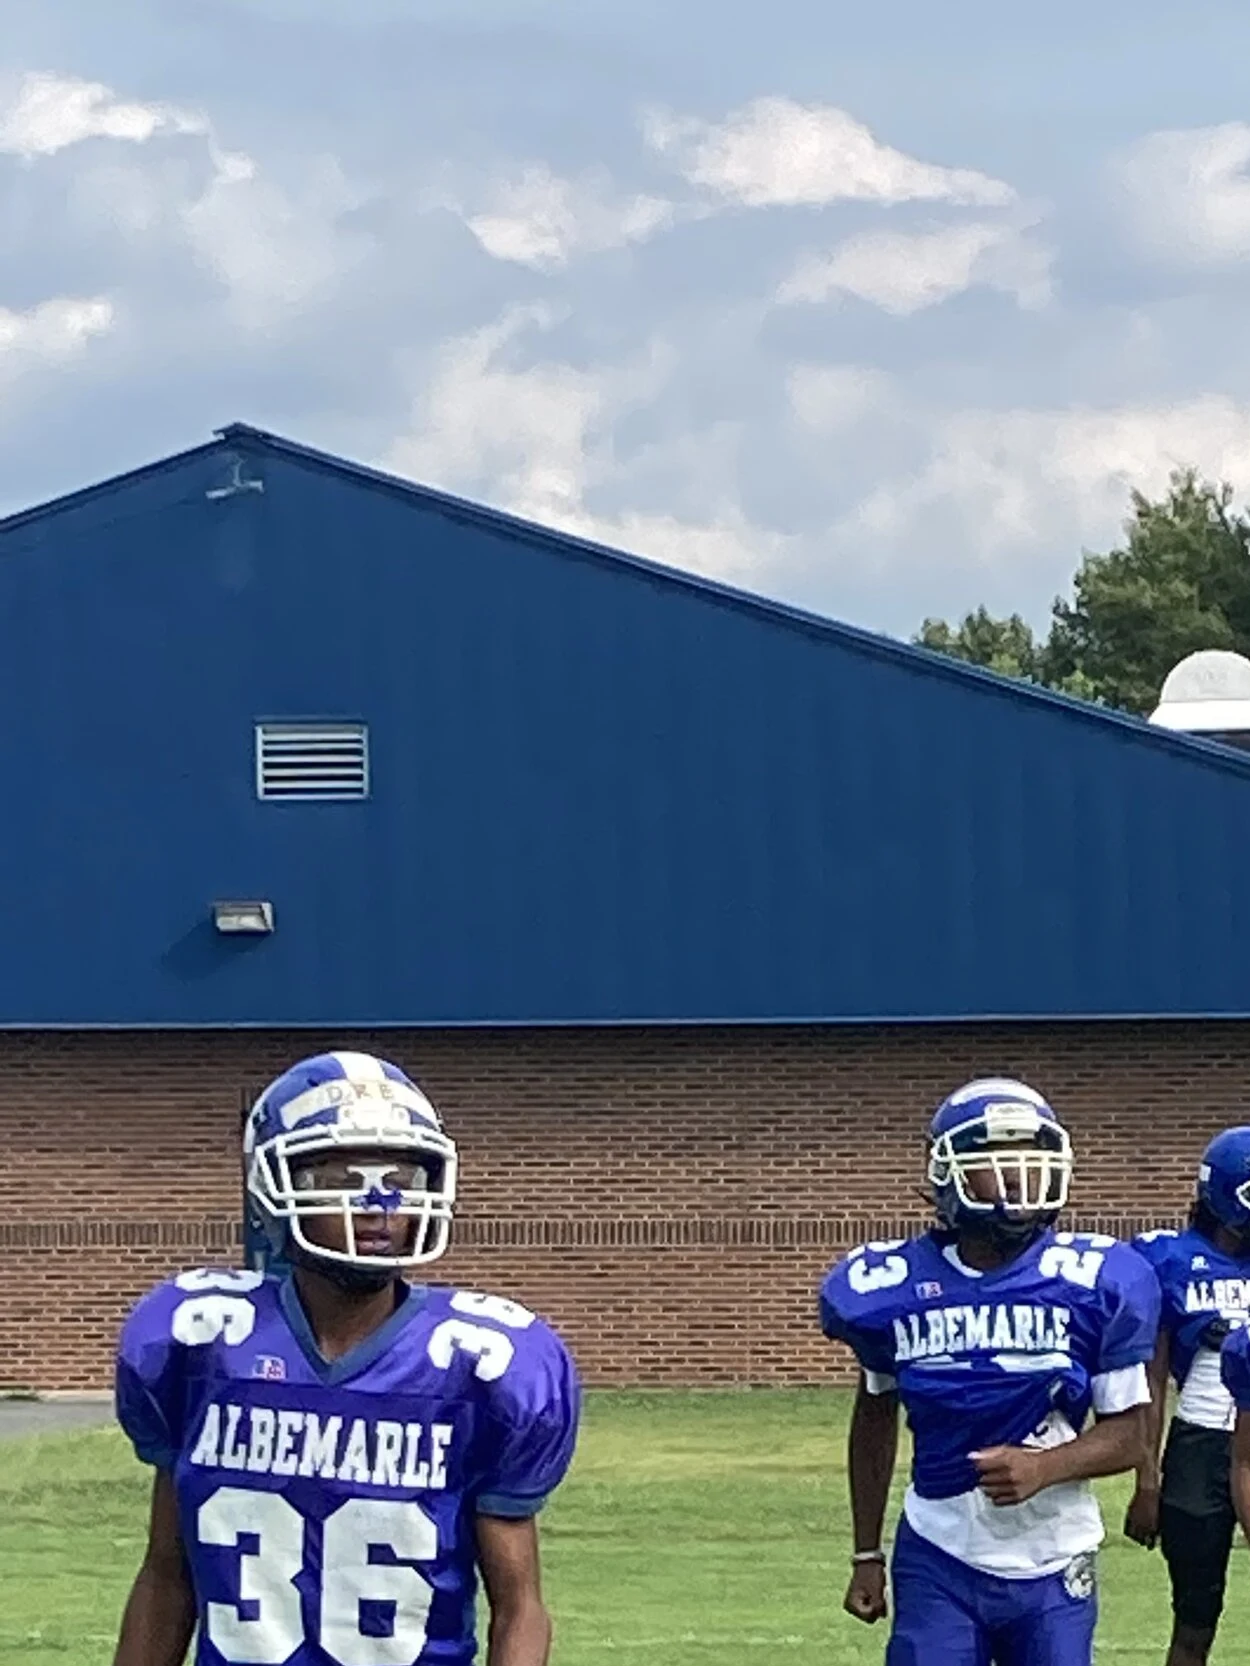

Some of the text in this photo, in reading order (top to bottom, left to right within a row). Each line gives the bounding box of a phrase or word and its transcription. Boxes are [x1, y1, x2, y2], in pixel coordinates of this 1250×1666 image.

[171, 1268, 264, 1346] 36
[426, 1291, 536, 1382] 36
[893, 1304, 1071, 1362] ALBEMARLE
[190, 1402, 453, 1490] ALBEMARLE
